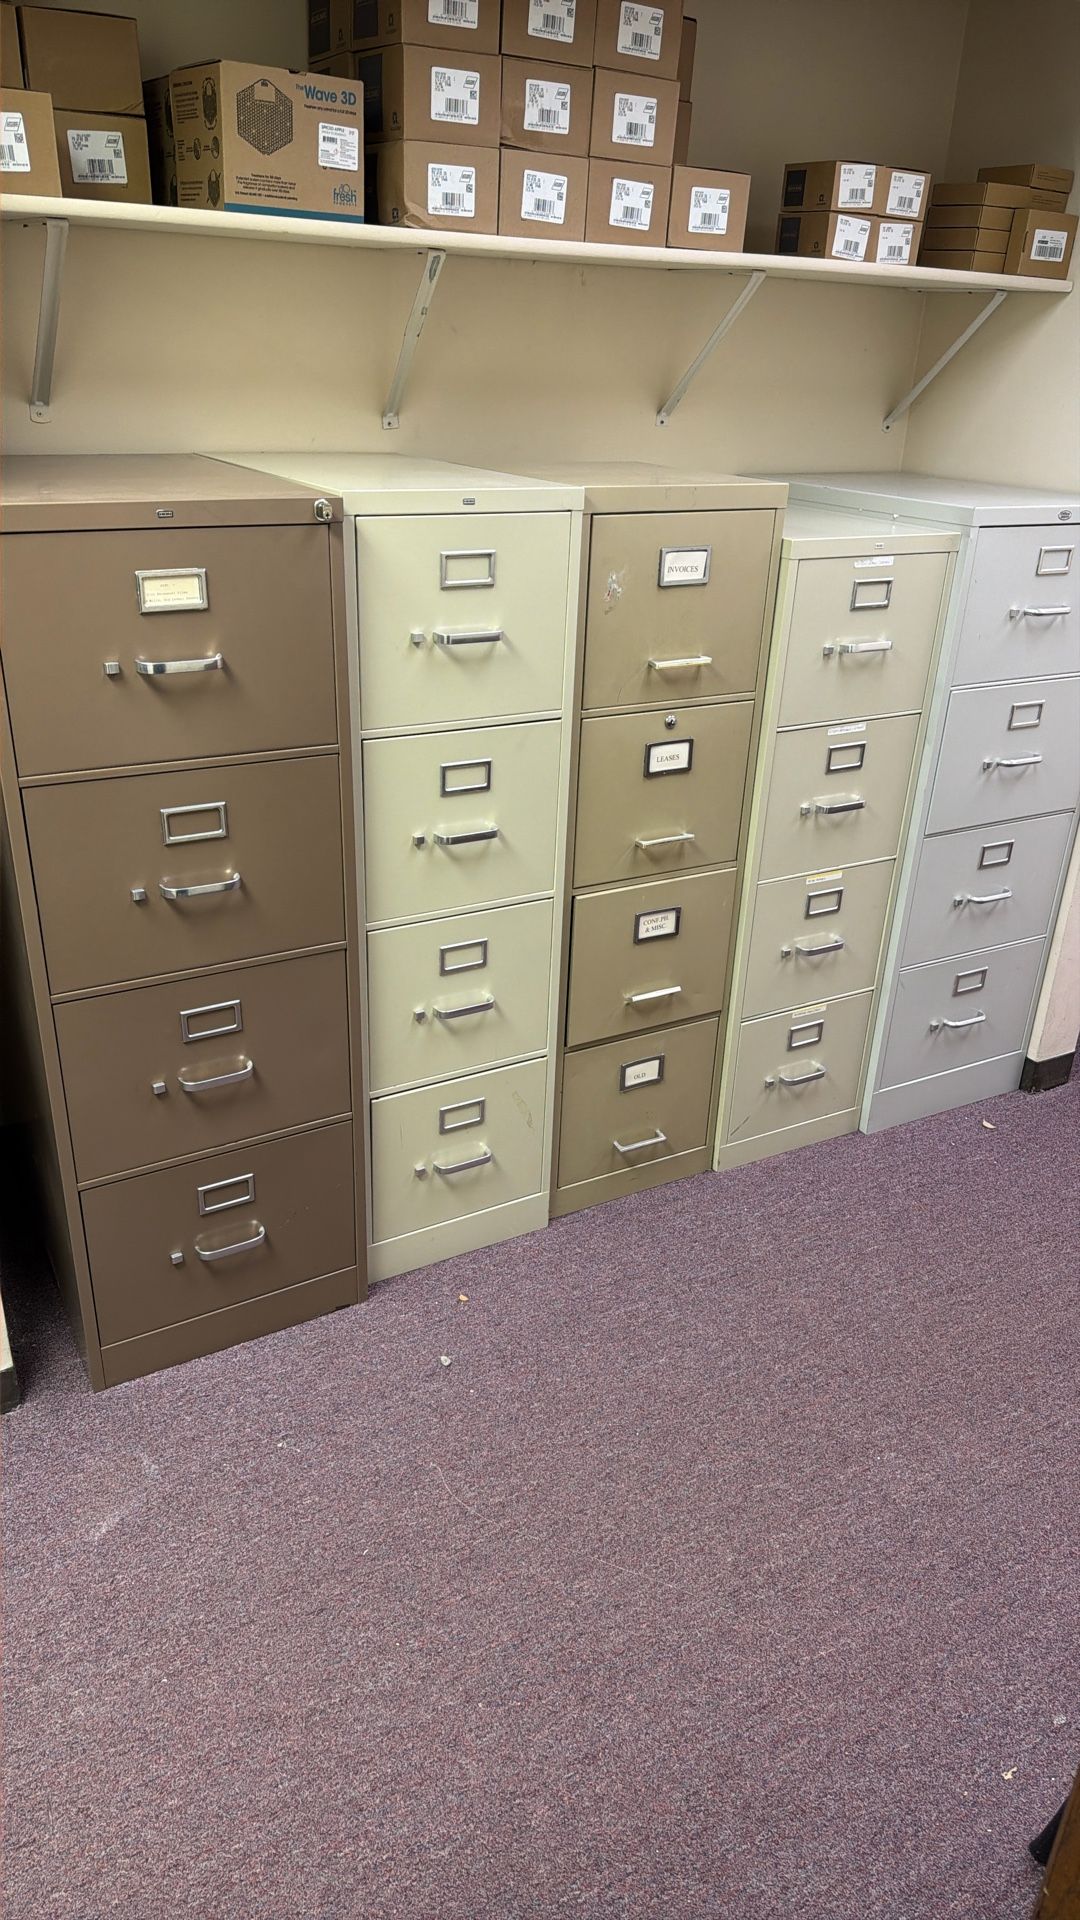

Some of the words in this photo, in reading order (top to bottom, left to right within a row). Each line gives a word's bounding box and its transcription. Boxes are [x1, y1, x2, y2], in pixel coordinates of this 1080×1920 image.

[296, 83, 304, 91] The
[304, 85, 337, 103] Wave
[341, 91, 357, 106] 3D
[333, 187, 357, 203] fresh
[667, 565, 699, 574] INVOICES
[656, 753, 680, 763] LEASES
[633, 1072, 647, 1081] OLD
